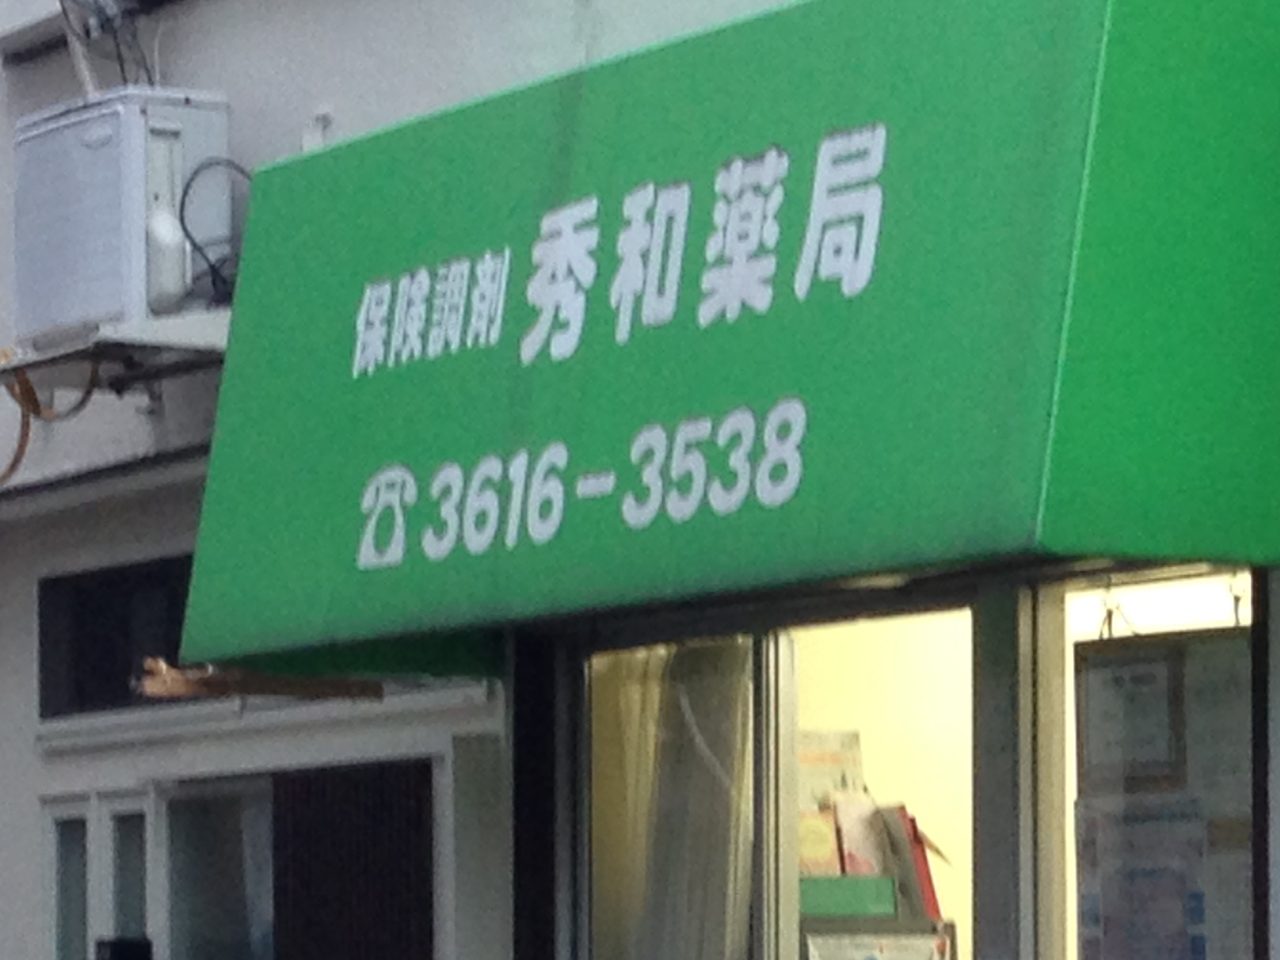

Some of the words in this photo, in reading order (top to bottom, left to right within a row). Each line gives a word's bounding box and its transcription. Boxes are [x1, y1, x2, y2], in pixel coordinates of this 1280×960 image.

[352, 246, 511, 378] 保険調剤
[519, 123, 887, 365] 秀和薬局
[420, 397, 807, 560] 3616-3538
